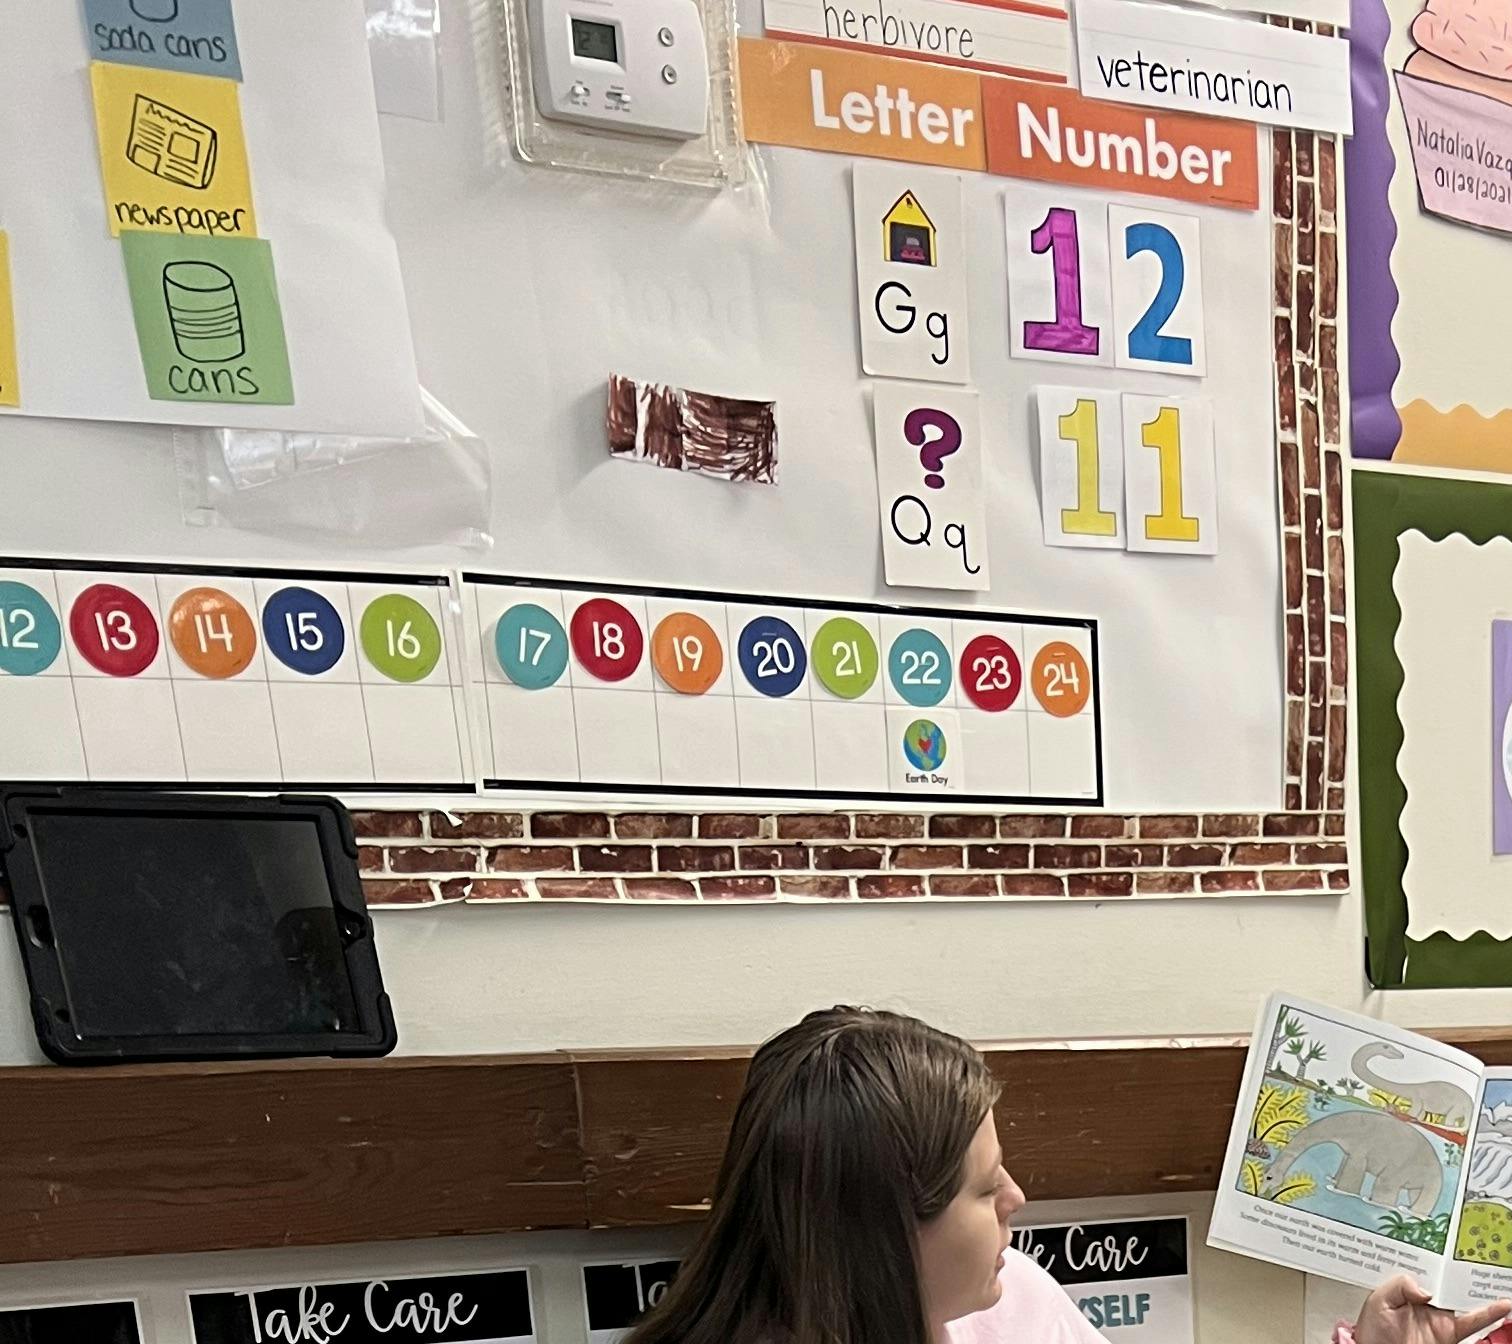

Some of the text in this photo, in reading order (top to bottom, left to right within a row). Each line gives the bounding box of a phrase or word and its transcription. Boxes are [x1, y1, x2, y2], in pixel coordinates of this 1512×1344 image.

[94, 23, 227, 62] soda cans
[824, 0, 975, 58] herbivore
[1097, 50, 1293, 112] veterinarian
[810, 69, 974, 147] Letter
[1016, 101, 1232, 187] Number
[1416, 118, 1476, 162] Natalia
[115, 201, 246, 234] newspaper
[168, 365, 260, 397] cans
[0, 608, 1080, 697] 12 13 14 15 16 17 18 19 20 21 22 23 24
[905, 772, 949, 787] Earth Day
[1064, 1225, 1149, 1273] Care
[234, 1280, 480, 1344] Take Care
